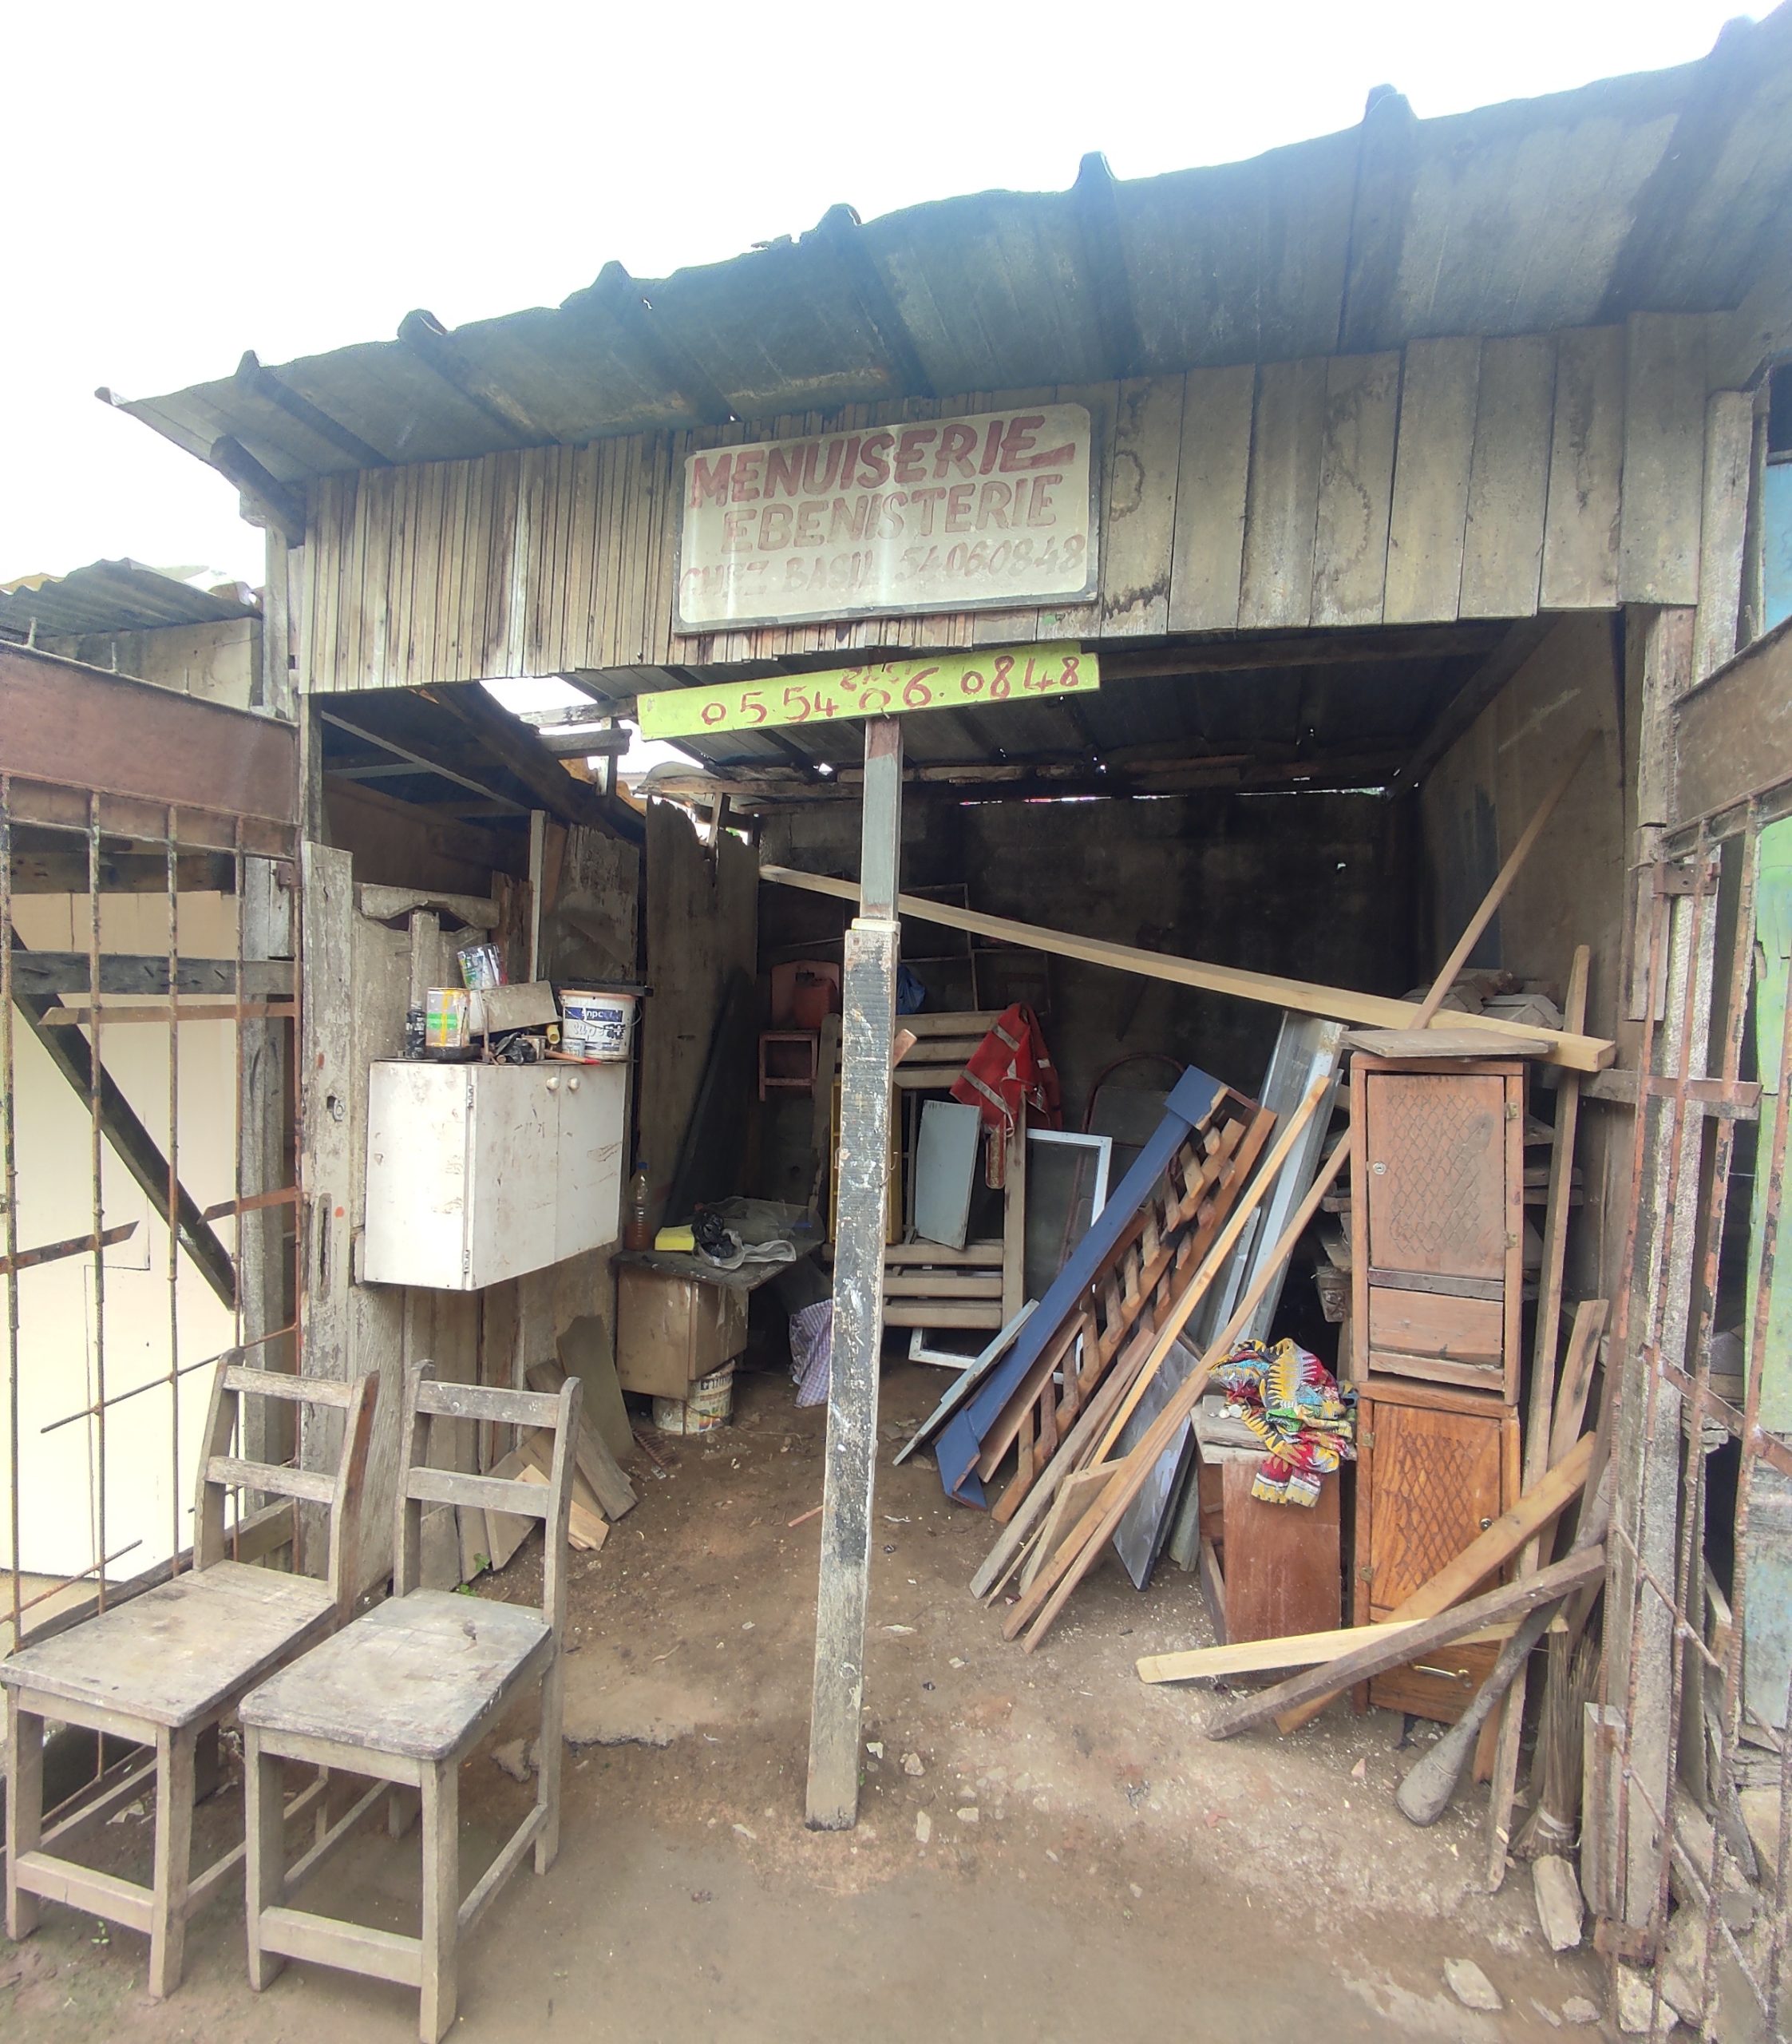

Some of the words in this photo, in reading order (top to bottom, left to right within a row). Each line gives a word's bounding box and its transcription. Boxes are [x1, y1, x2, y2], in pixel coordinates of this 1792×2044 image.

[690, 414, 1076, 509] MENUISERIE
[720, 473, 1063, 554] EBENISTERIE
[894, 533, 1086, 581] 54060848
